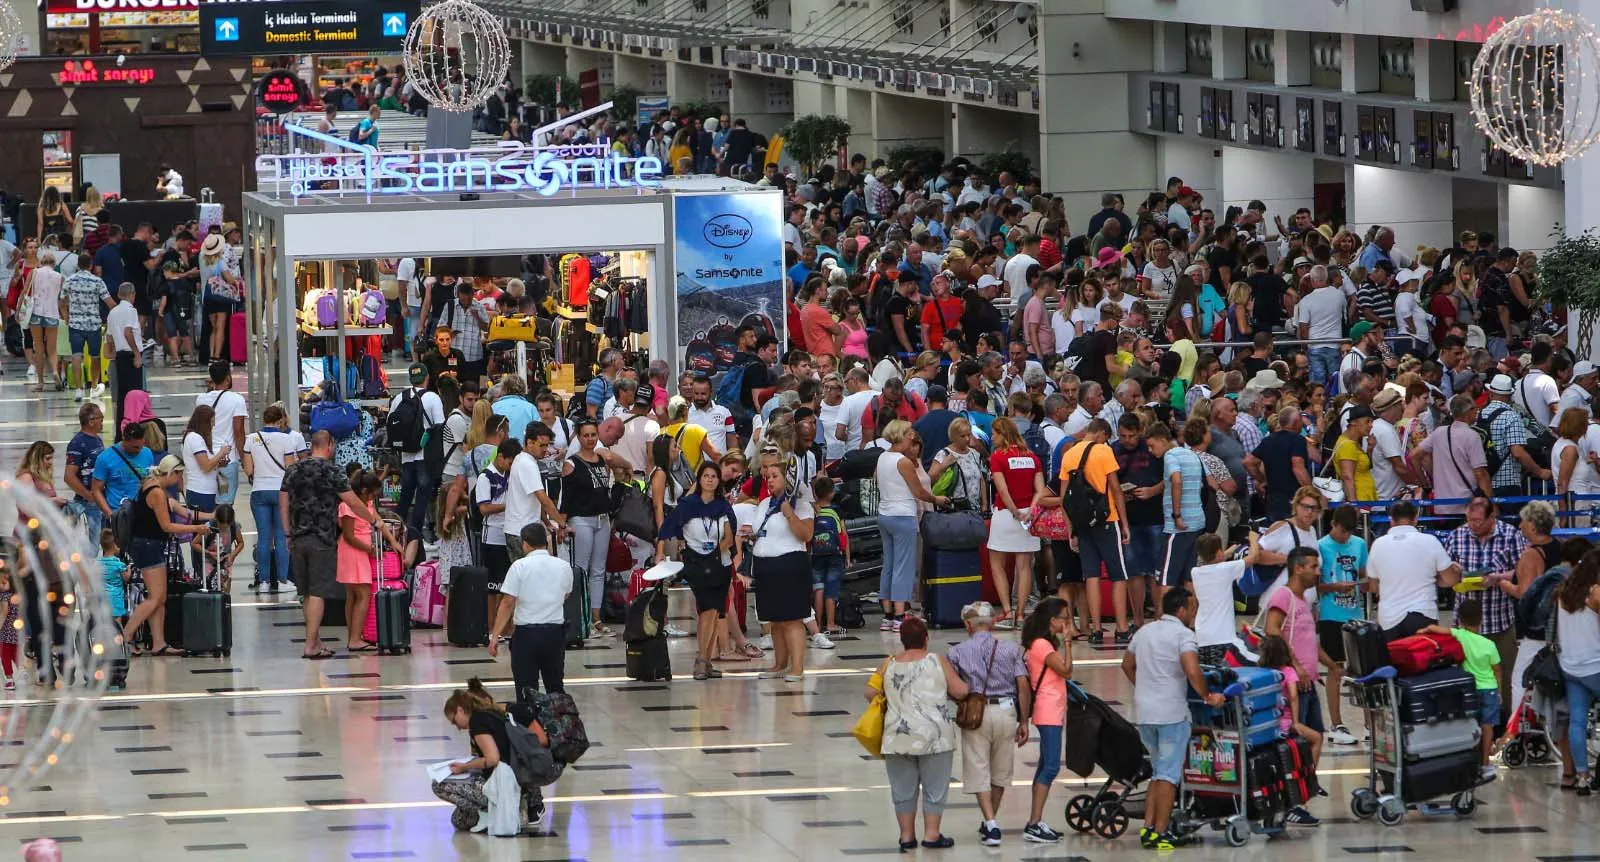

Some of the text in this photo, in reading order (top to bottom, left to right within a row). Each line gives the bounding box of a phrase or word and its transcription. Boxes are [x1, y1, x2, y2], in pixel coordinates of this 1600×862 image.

[264, 11, 357, 28] İç Hatlar Terminali
[265, 28, 357, 43] Domestic Terminal
[60, 60, 97, 82] simit
[289, 159, 357, 177] House
[379, 152, 663, 196] Samsonite
[724, 253, 733, 262] by
[695, 268, 763, 279] Samsonite
[1190, 741, 1235, 763] Have fun!
